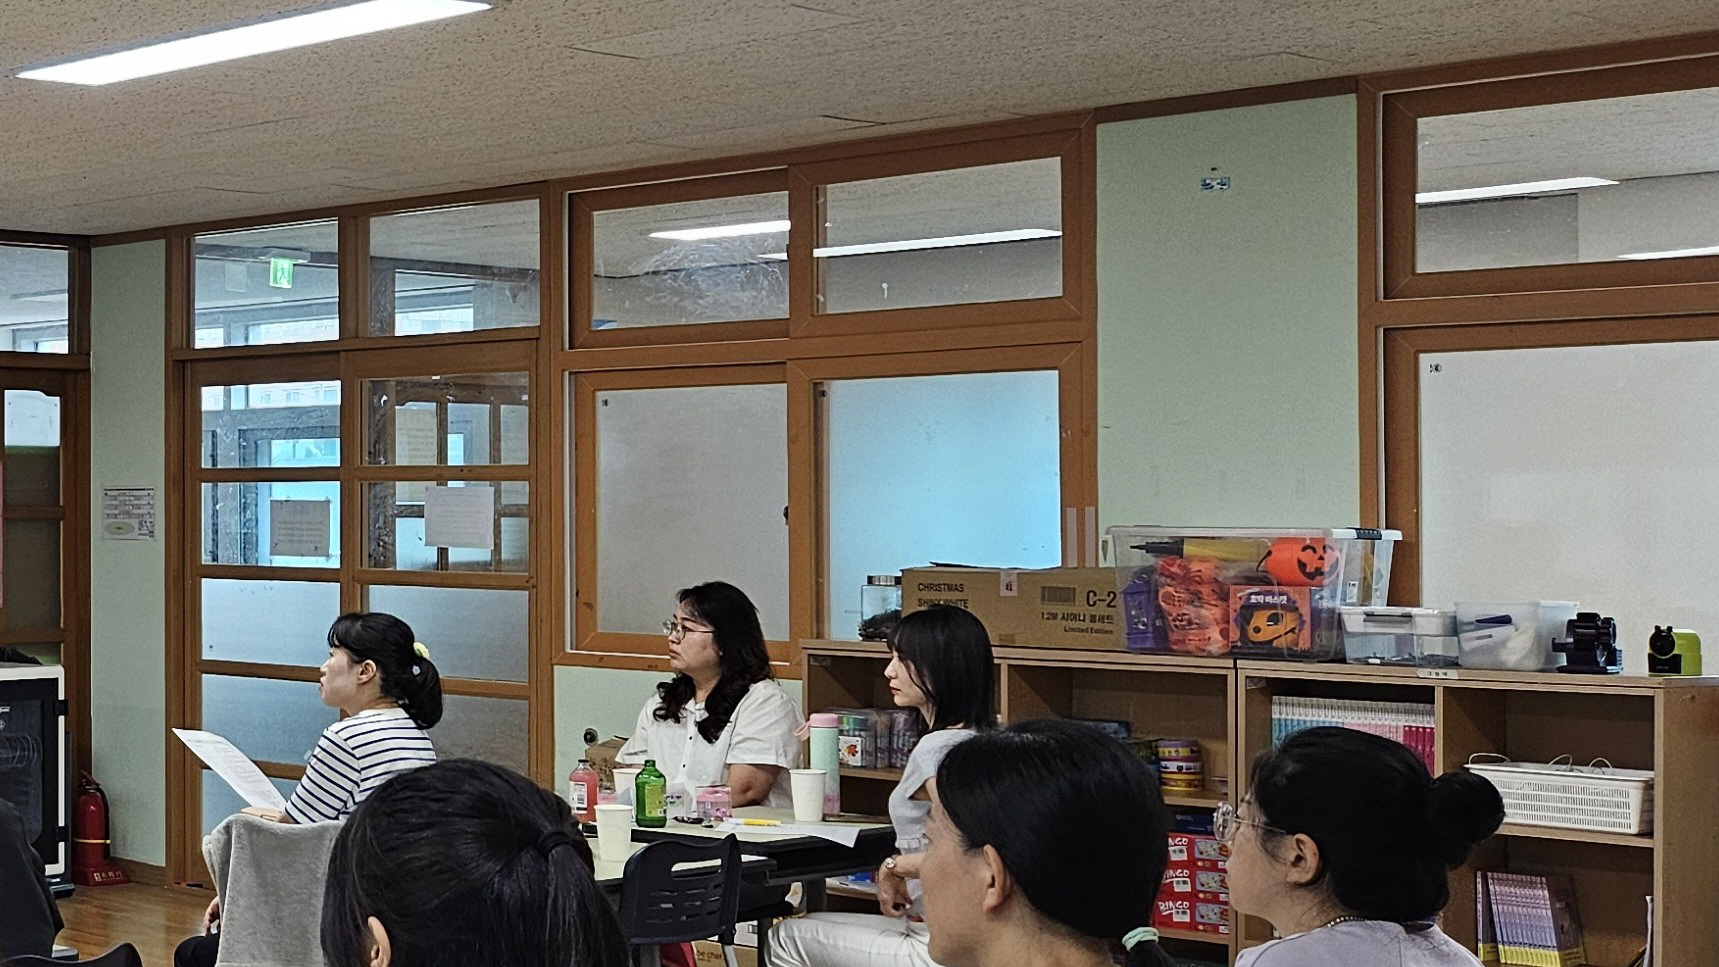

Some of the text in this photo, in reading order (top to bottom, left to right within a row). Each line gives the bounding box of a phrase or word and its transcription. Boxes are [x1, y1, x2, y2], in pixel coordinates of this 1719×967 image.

[918, 583, 964, 592] CHRISTMAS
[1086, 590, 1117, 608] C-2
[1168, 838, 1188, 847] NGO
[1165, 870, 1189, 878] INGO
[1158, 901, 1190, 912] BINGO
